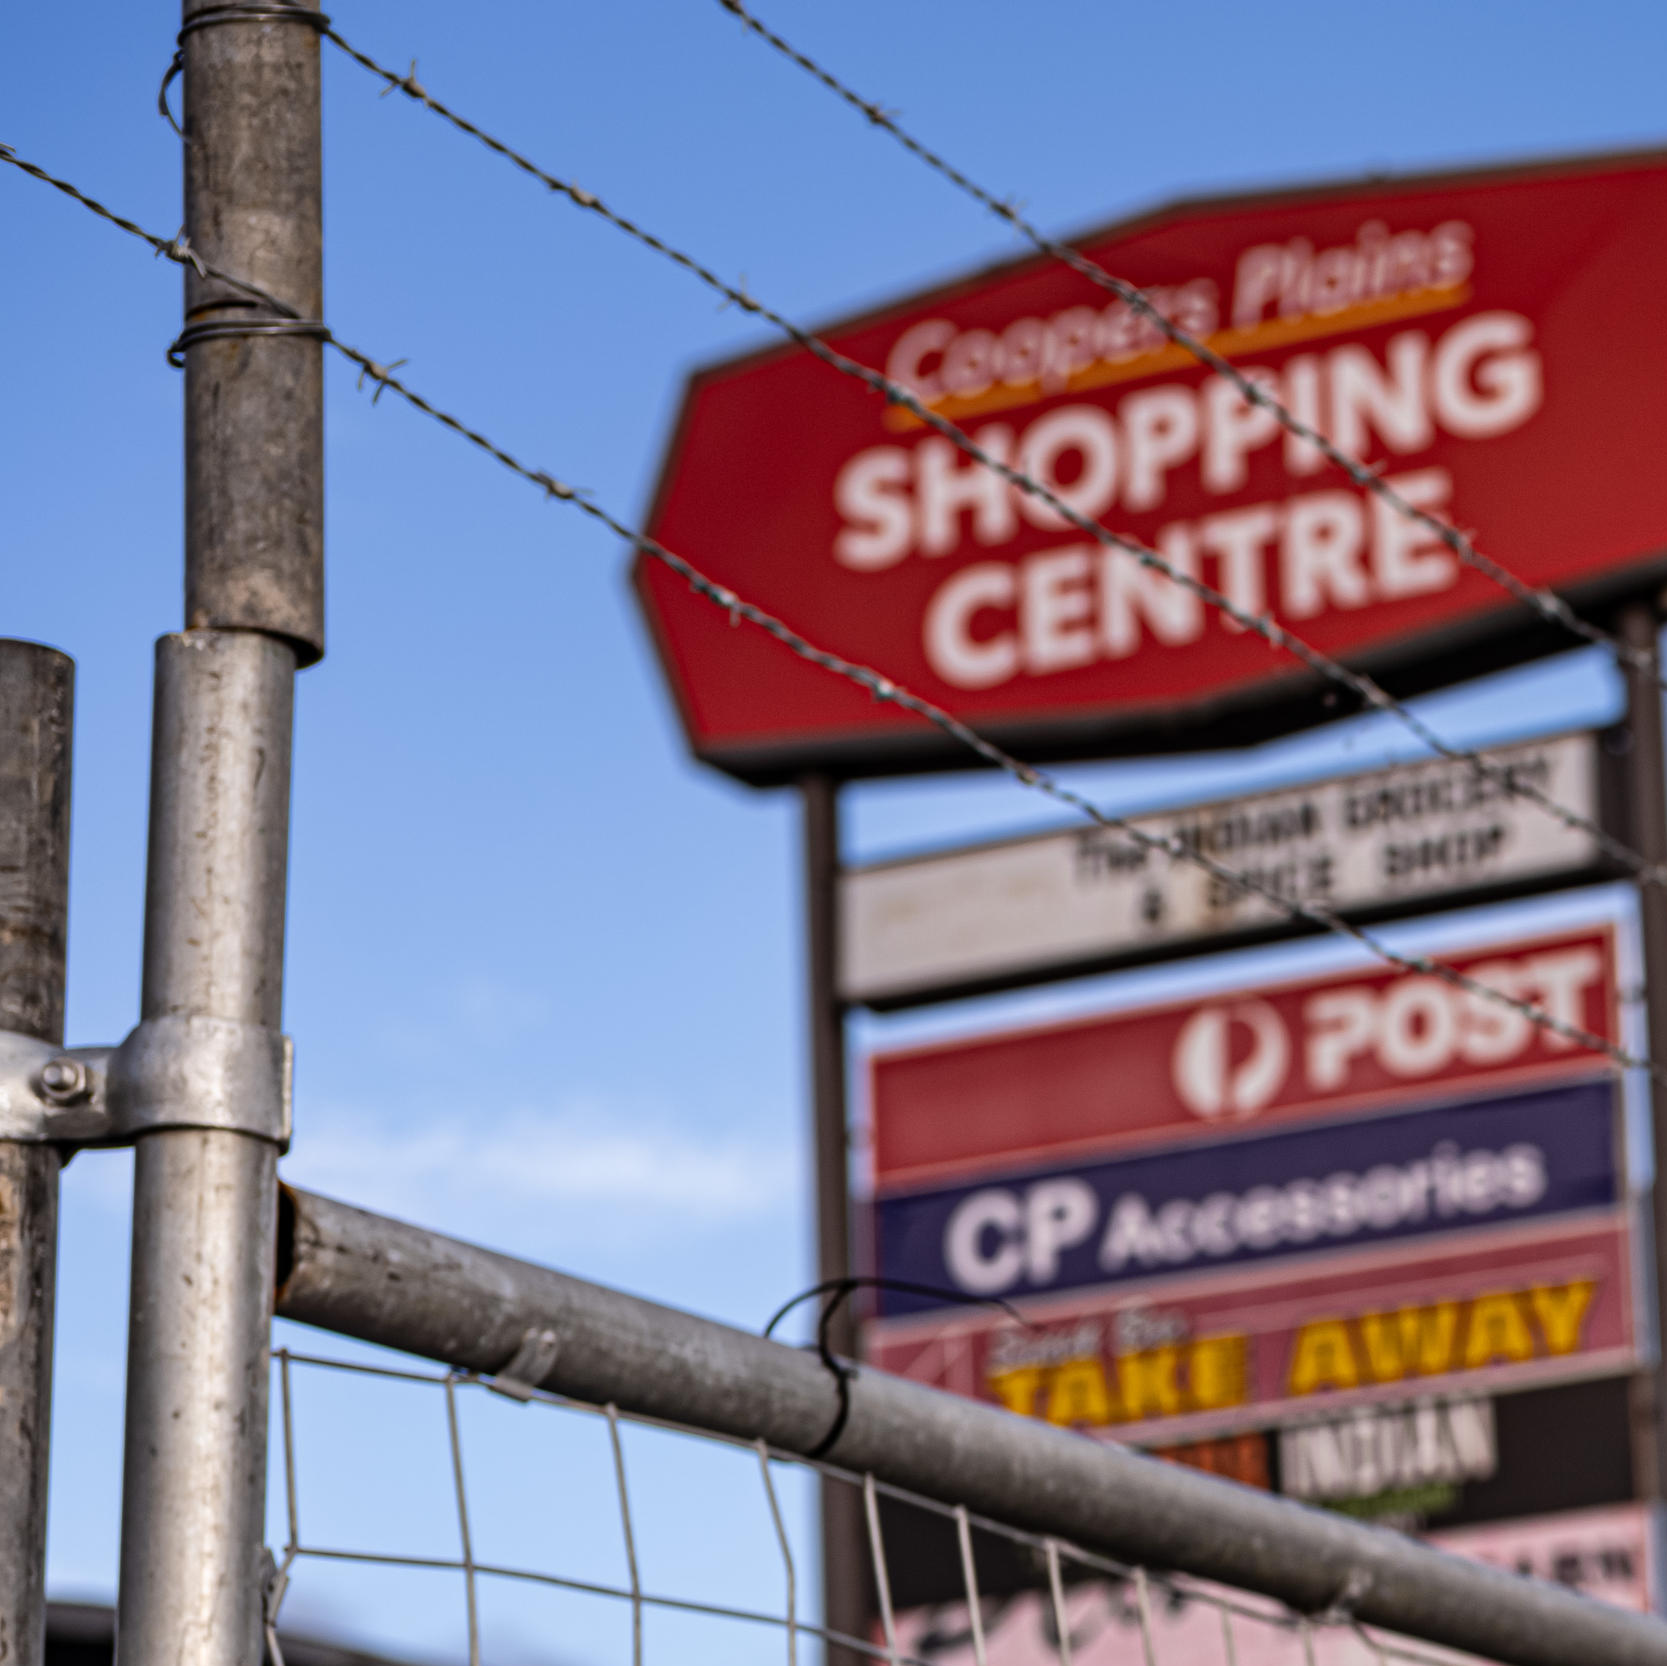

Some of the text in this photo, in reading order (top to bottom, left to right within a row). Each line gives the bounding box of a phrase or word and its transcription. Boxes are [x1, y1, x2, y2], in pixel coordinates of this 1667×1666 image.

[884, 220, 1475, 405] Coopers Plains
[832, 308, 1544, 572] SHOPPING
[922, 466, 1462, 690] CENTRE
[1305, 947, 1602, 1091] POST
[945, 1142, 1545, 1292] CP Accessories
[986, 1278, 1597, 1428] TAKE AWAY
